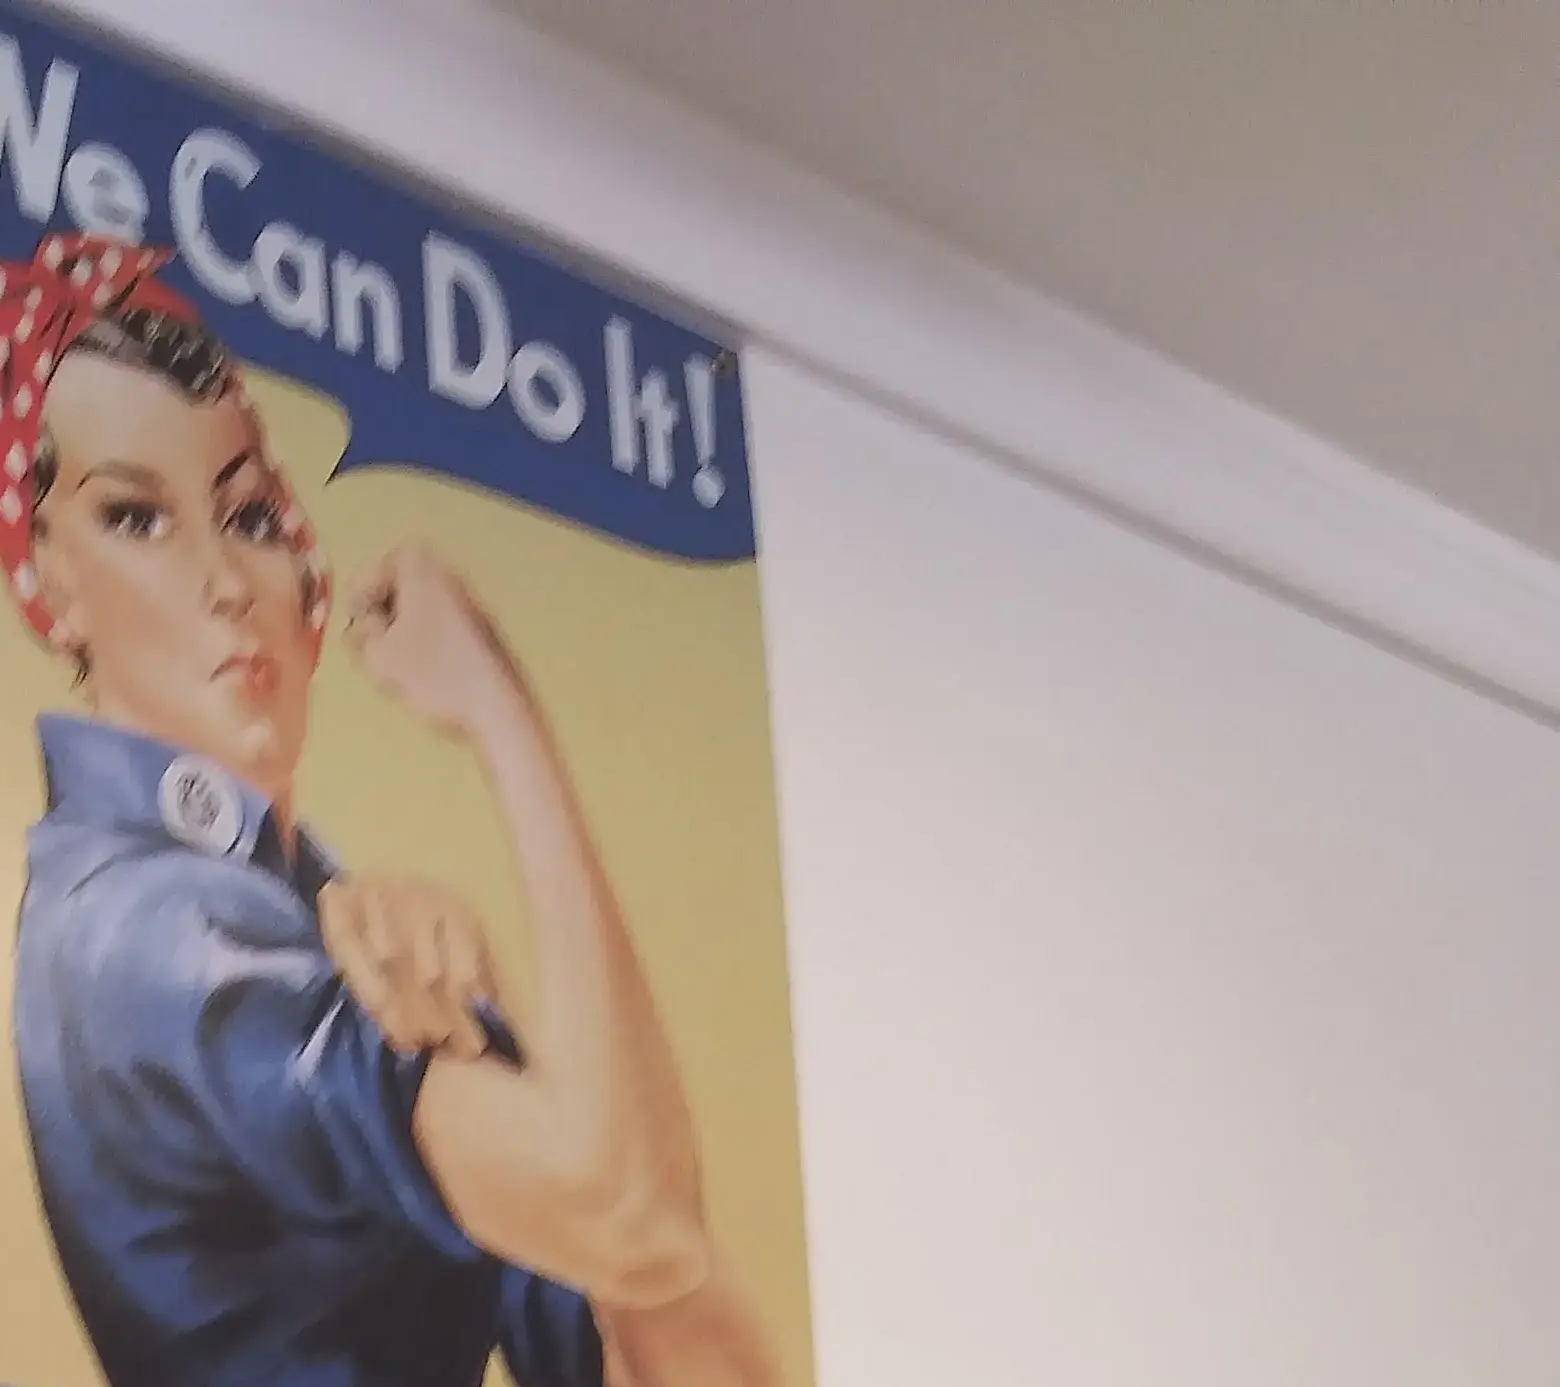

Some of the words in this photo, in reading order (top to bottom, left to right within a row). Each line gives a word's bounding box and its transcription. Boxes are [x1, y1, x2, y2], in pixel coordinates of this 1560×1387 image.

[169, 128, 403, 373] Can
[423, 229, 586, 442] Do
[603, 312, 726, 509] It!
